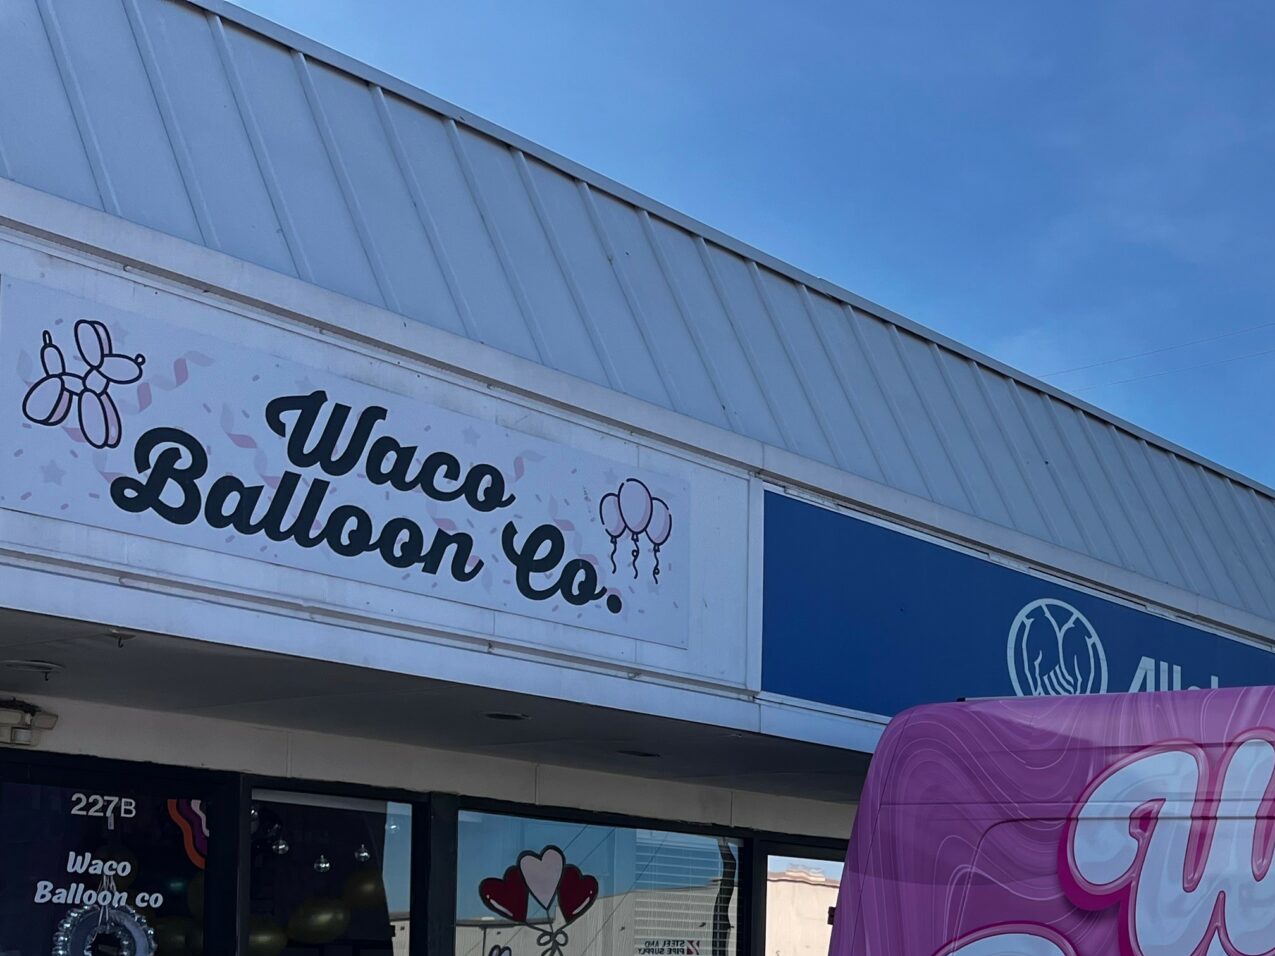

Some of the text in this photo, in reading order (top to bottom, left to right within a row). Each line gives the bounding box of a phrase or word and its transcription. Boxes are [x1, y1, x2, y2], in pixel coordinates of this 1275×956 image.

[265, 390, 516, 513] Waco
[109, 426, 624, 614] Balloon Co.
[70, 792, 137, 818] 227B
[66, 850, 132, 877] Waco
[34, 880, 163, 908] Balloon co
